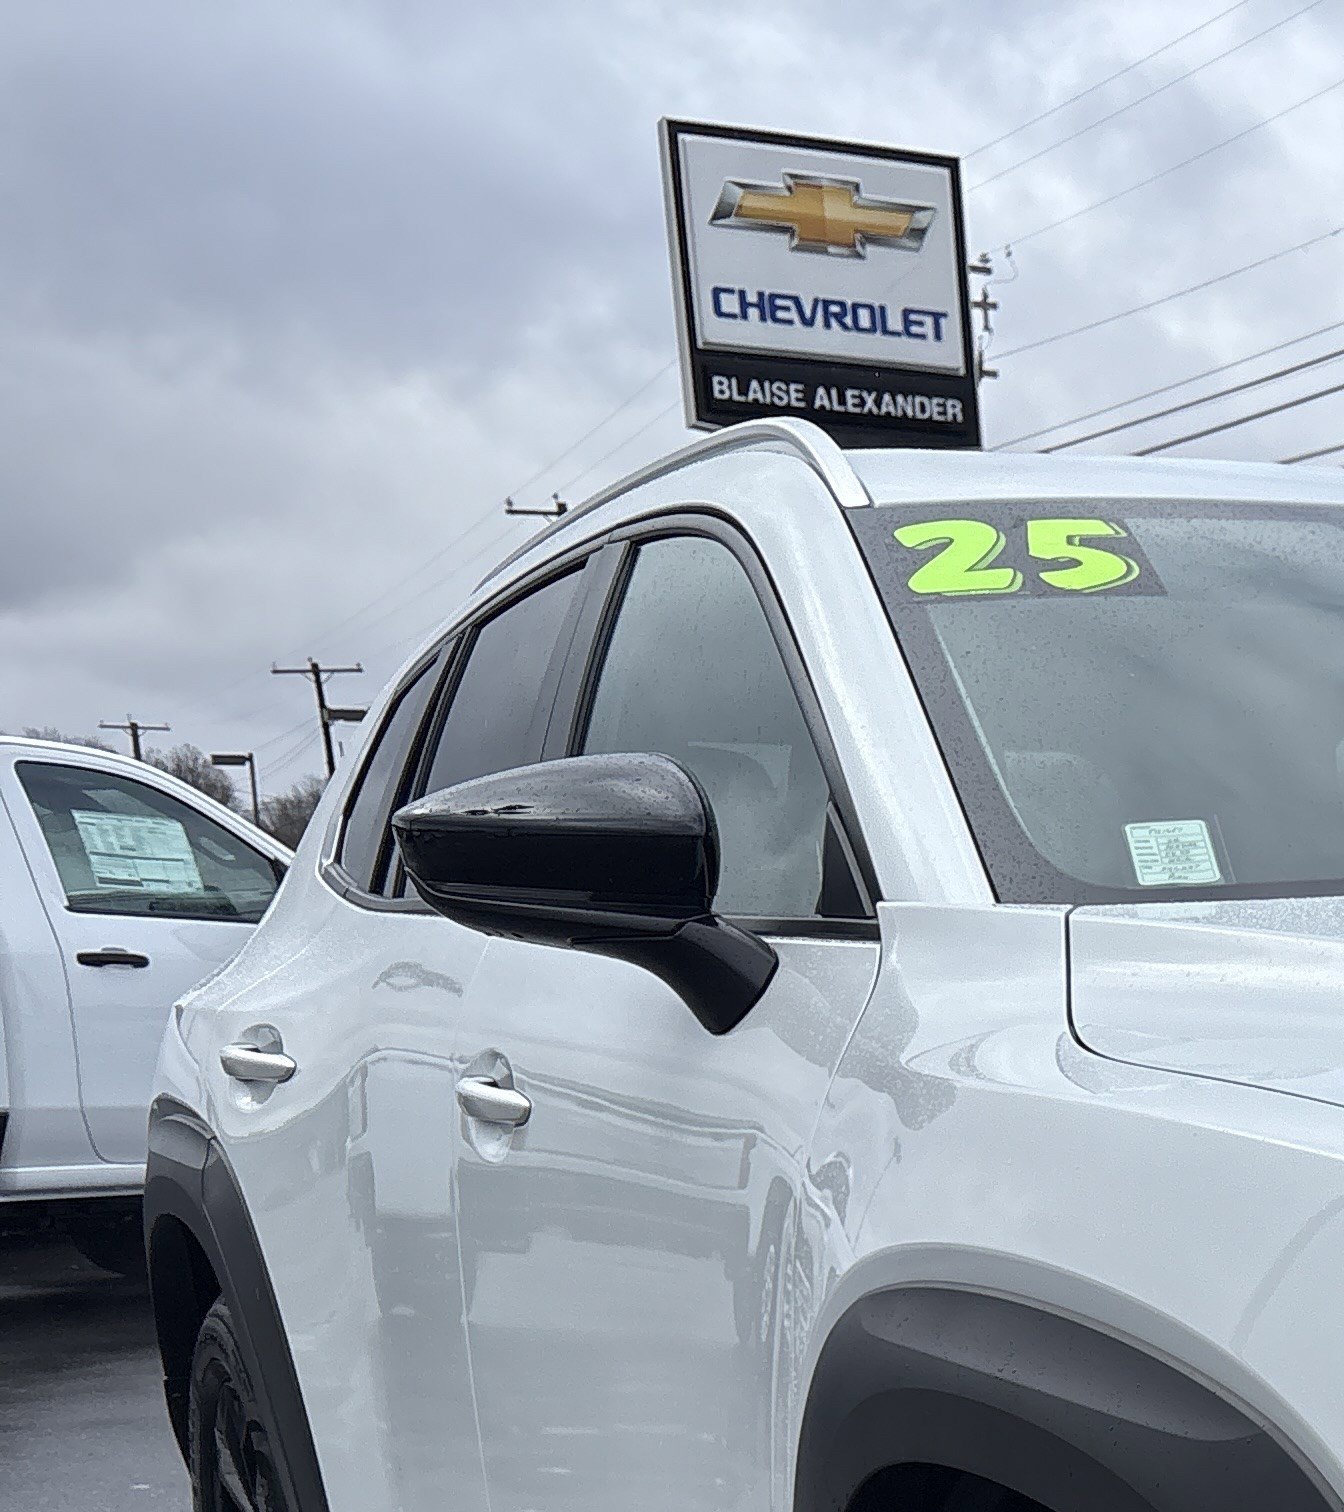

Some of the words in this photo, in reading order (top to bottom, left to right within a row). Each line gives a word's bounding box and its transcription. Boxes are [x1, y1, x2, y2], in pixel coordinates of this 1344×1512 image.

[711, 285, 949, 343] CHEVROLET
[710, 373, 807, 409] BLAISE
[813, 385, 965, 424] ALEXANDER
[892, 517, 1141, 597] 25
